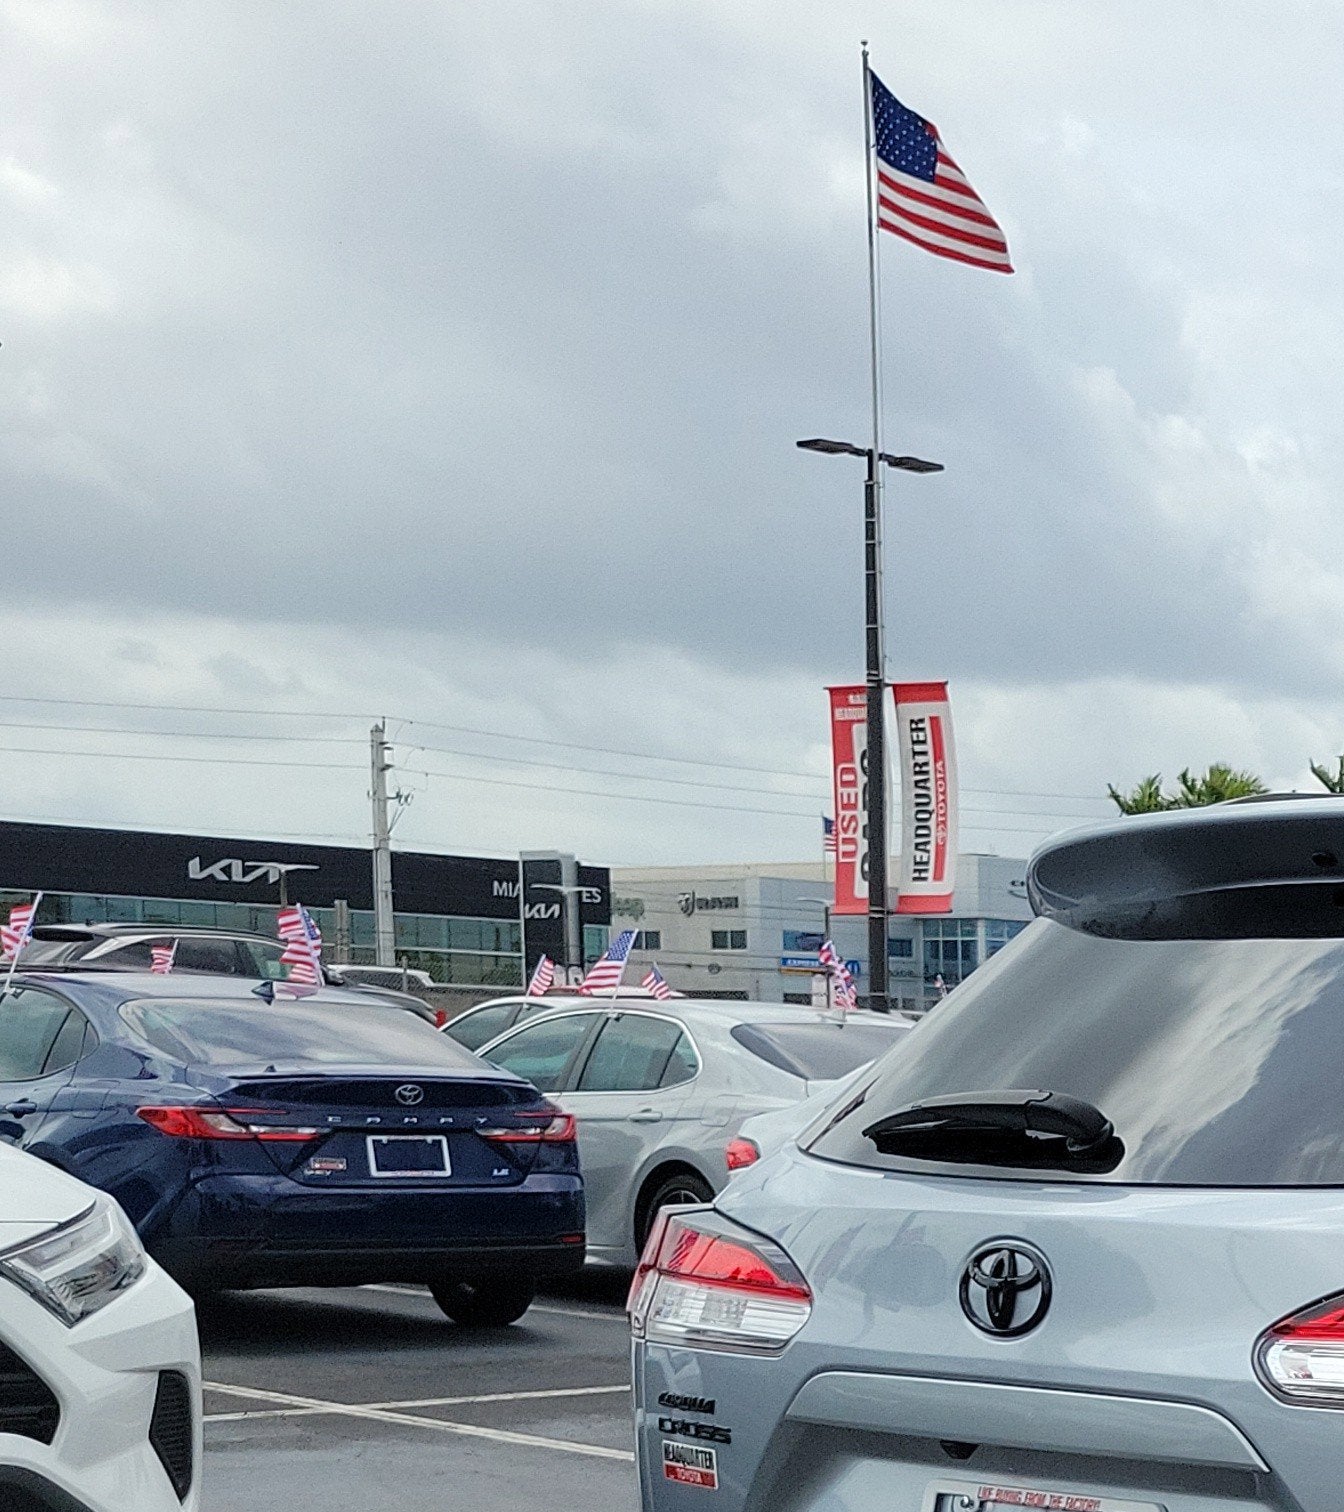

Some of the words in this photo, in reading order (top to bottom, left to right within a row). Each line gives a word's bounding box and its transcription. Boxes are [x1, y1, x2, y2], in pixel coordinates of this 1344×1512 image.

[838, 763, 858, 862] USED
[910, 717, 933, 882] HEADQUARTER
[934, 761, 949, 823] TOYOTA
[188, 856, 280, 884] KIA
[524, 903, 561, 919] KIA
[658, 1417, 732, 1445] CROSS
